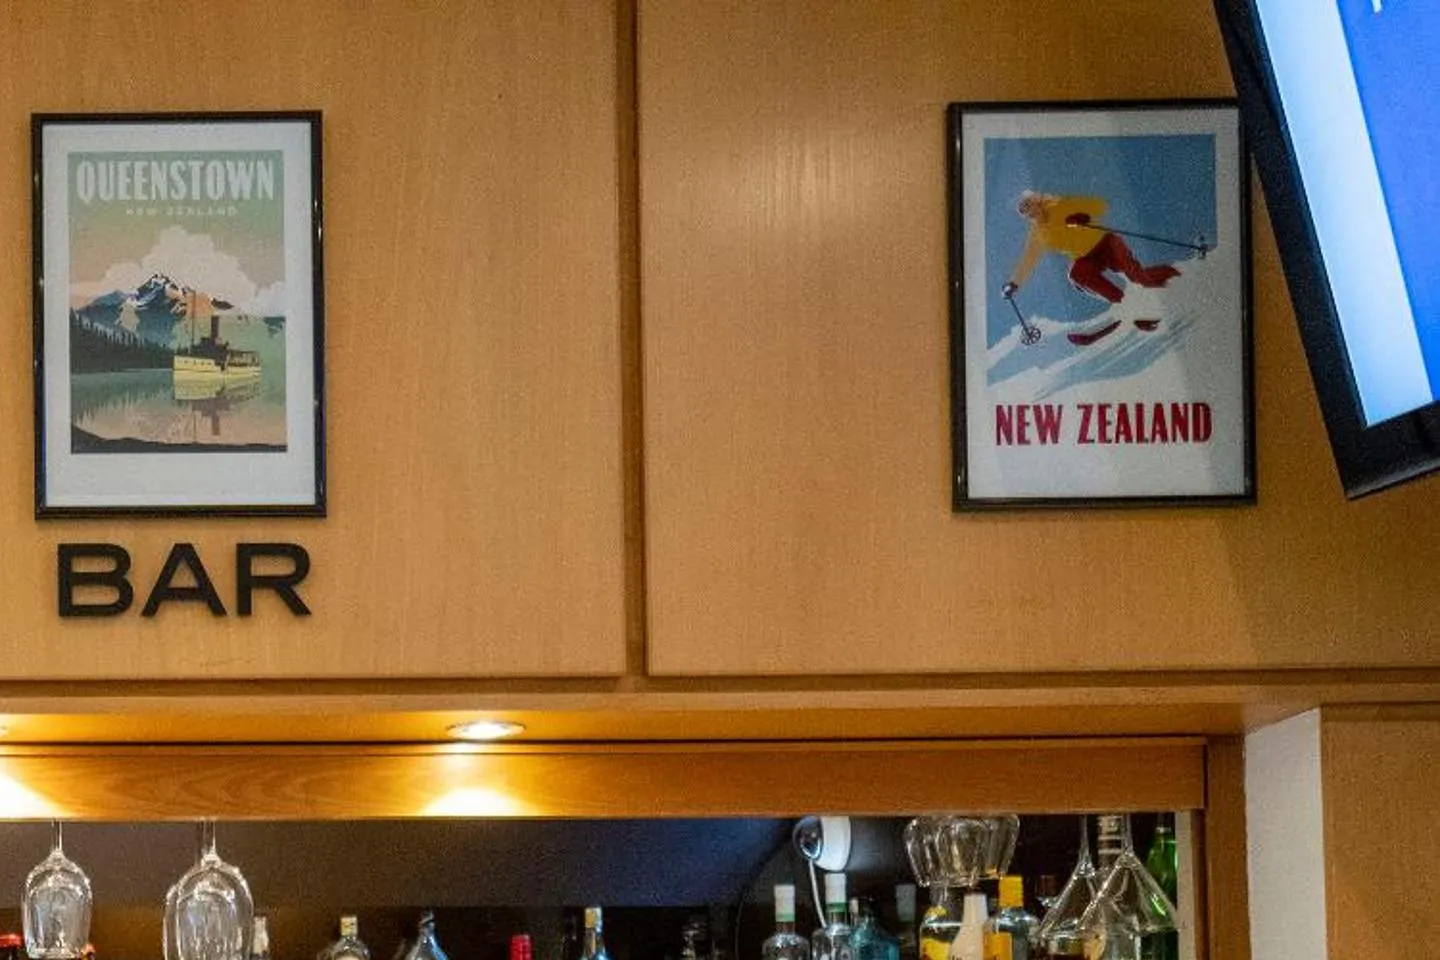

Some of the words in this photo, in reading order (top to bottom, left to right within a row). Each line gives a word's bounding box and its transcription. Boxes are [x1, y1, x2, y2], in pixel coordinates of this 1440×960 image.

[76, 159, 274, 202] QUEENSTOWN
[995, 404, 1063, 446] NEW
[1077, 401, 1214, 445] ZEALAND
[57, 542, 312, 619] BAR
